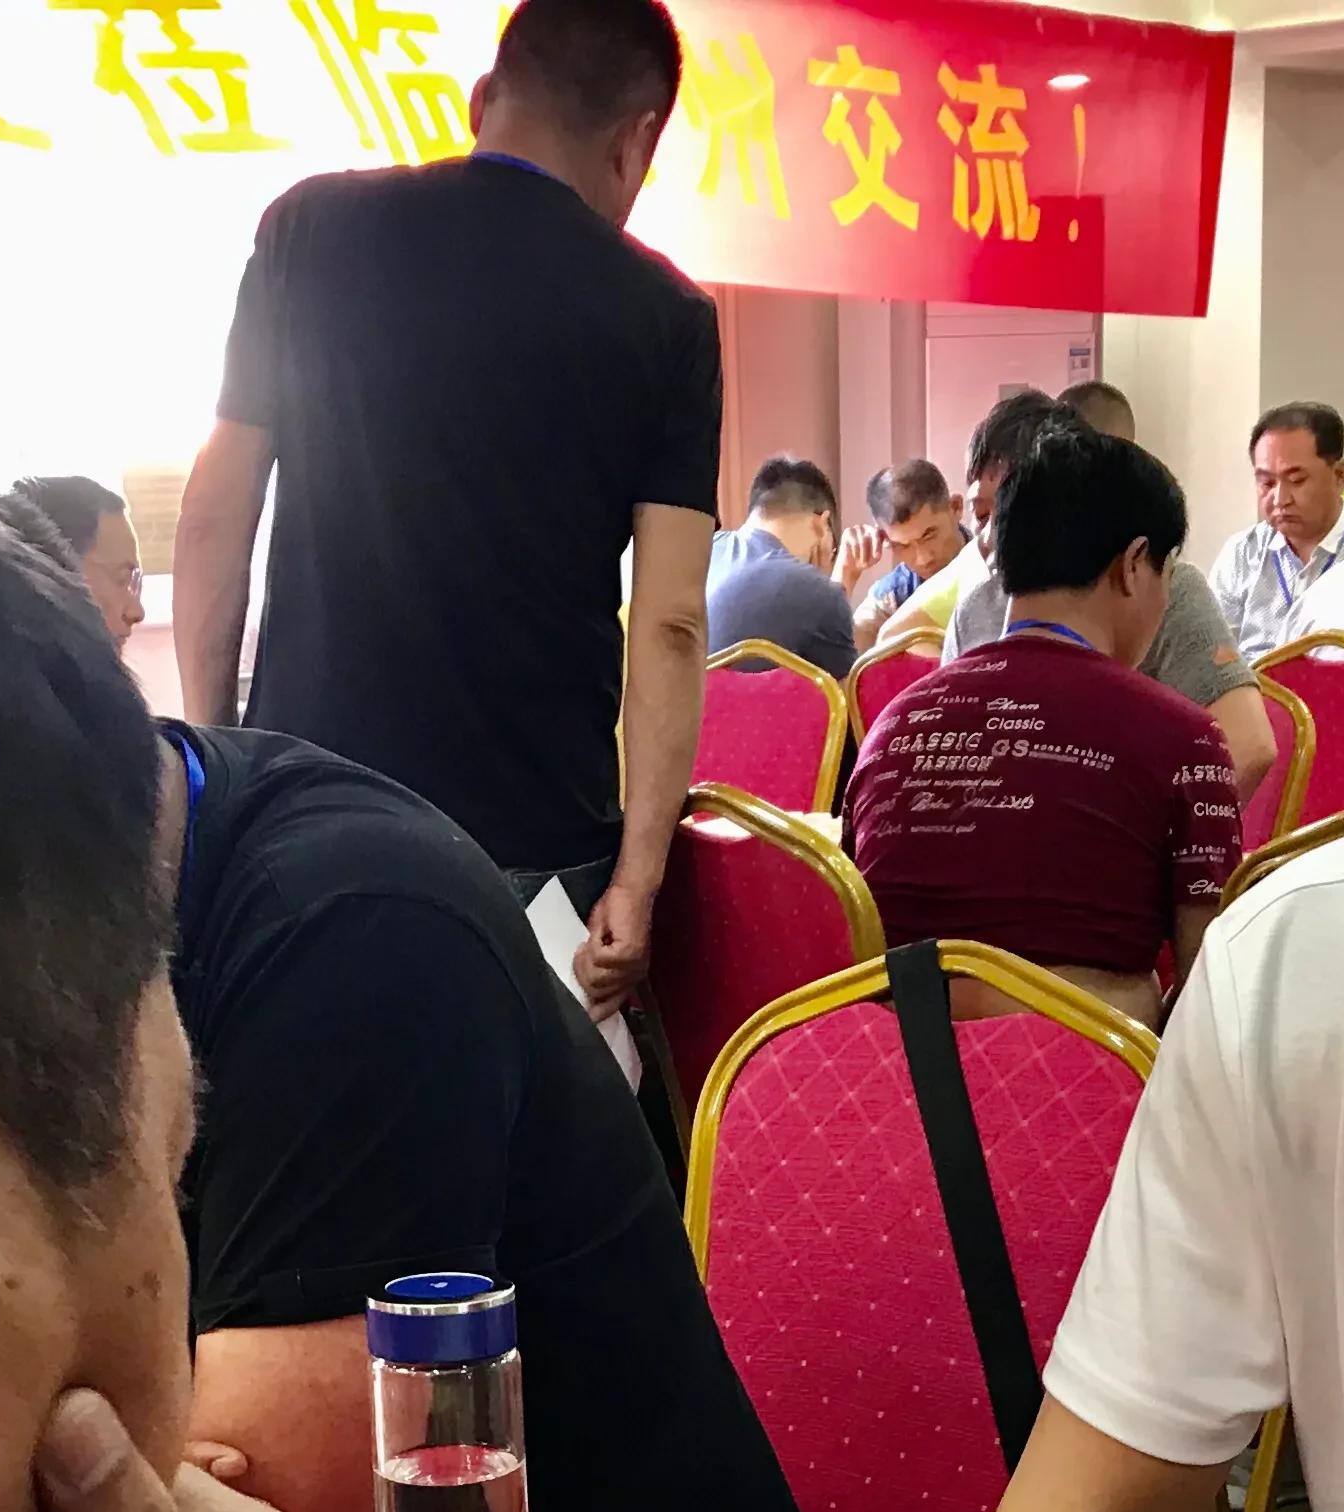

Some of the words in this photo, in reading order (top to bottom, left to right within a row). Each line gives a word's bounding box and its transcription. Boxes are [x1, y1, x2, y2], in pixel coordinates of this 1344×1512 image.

[986, 717, 1046, 730] Classic
[888, 732, 983, 755] CLASSIC
[913, 755, 994, 772] FASHION
